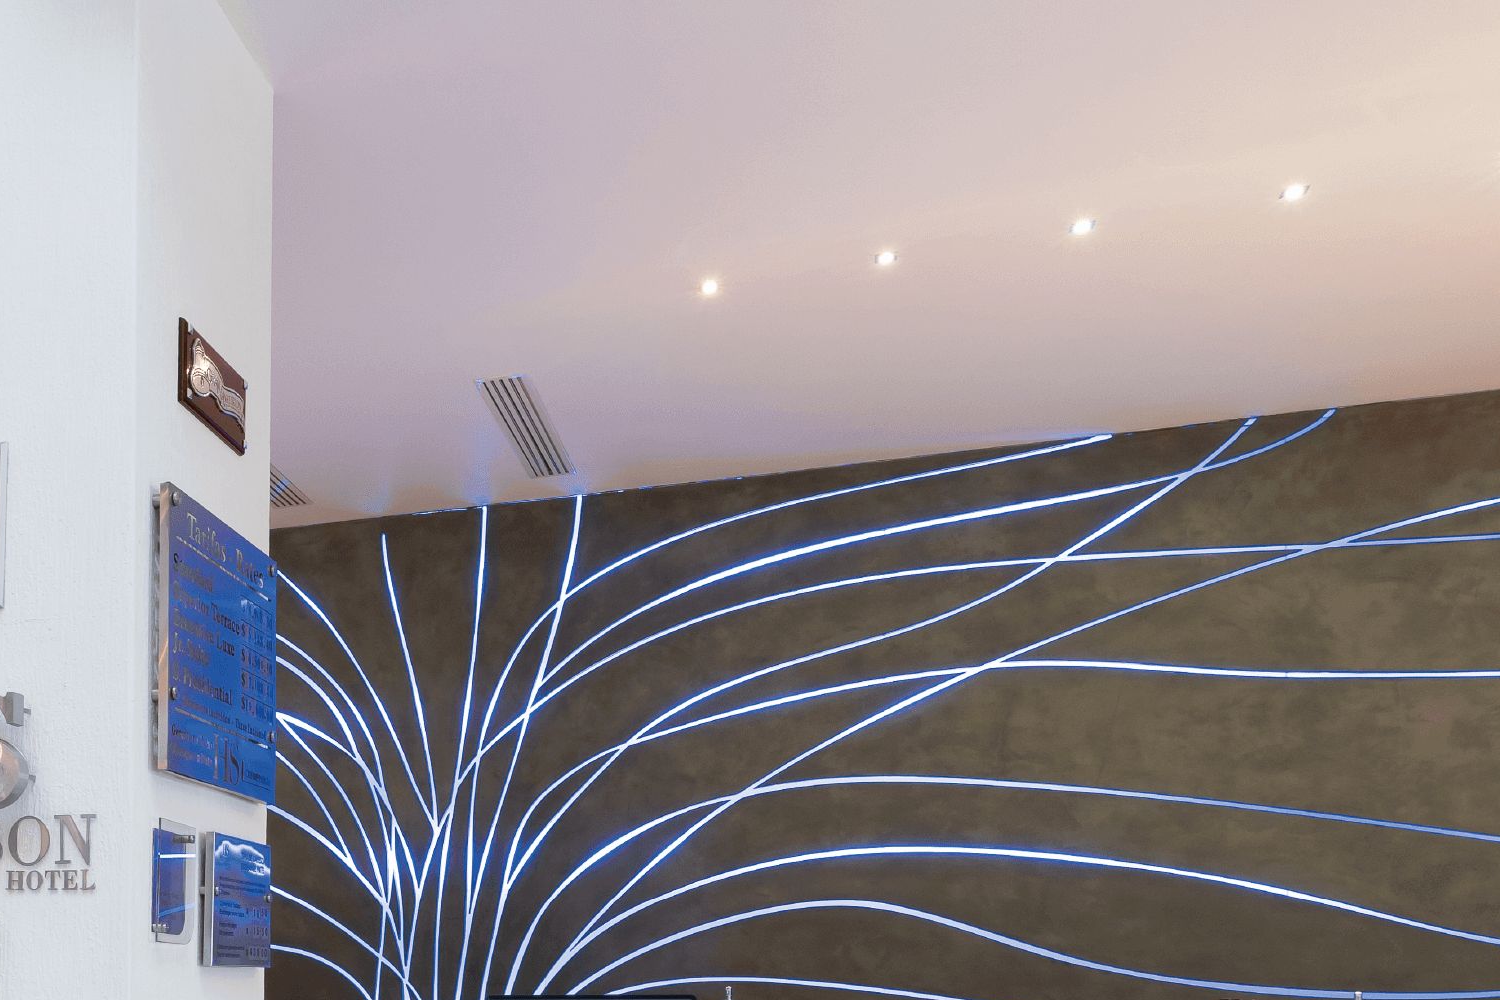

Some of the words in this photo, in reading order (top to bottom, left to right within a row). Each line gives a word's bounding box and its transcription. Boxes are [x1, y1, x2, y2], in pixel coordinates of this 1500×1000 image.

[187, 513, 226, 562] Tarifas
[211, 603, 241, 634] Terrace
[4, 869, 97, 892] HOTEL
